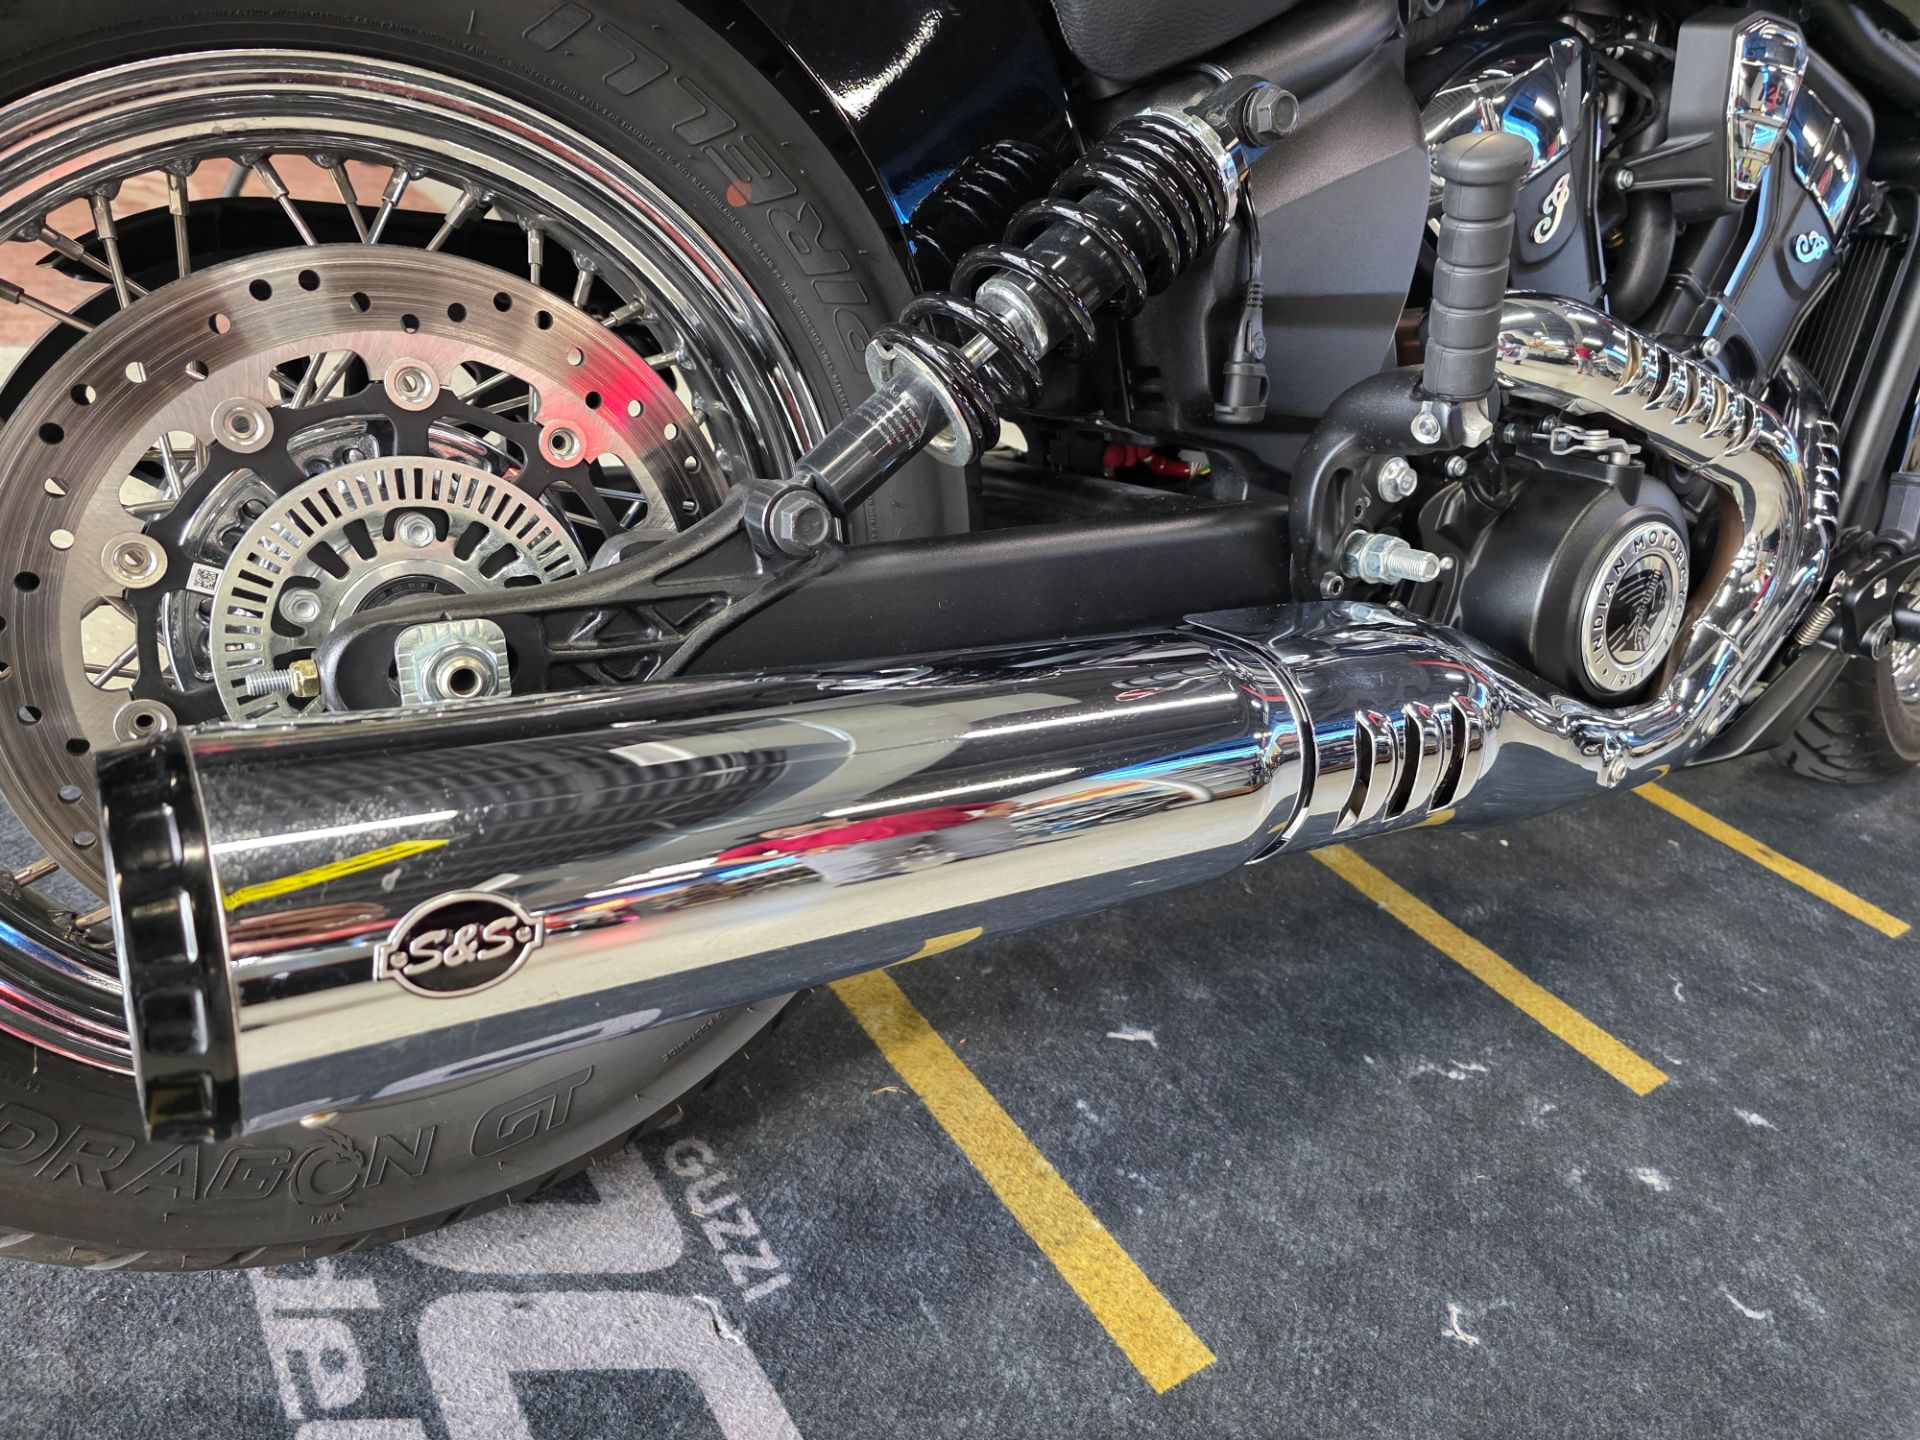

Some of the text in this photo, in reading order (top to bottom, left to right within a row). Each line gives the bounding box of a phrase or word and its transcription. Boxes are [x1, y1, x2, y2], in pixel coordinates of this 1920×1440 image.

[1593, 530, 1688, 664] INDIAN MOTORCYCLE
[1611, 668, 1645, 686] 1901
[403, 916, 518, 976] S&S
[470, 1064, 594, 1157] GT
[664, 1139, 791, 1302] GUZZI
